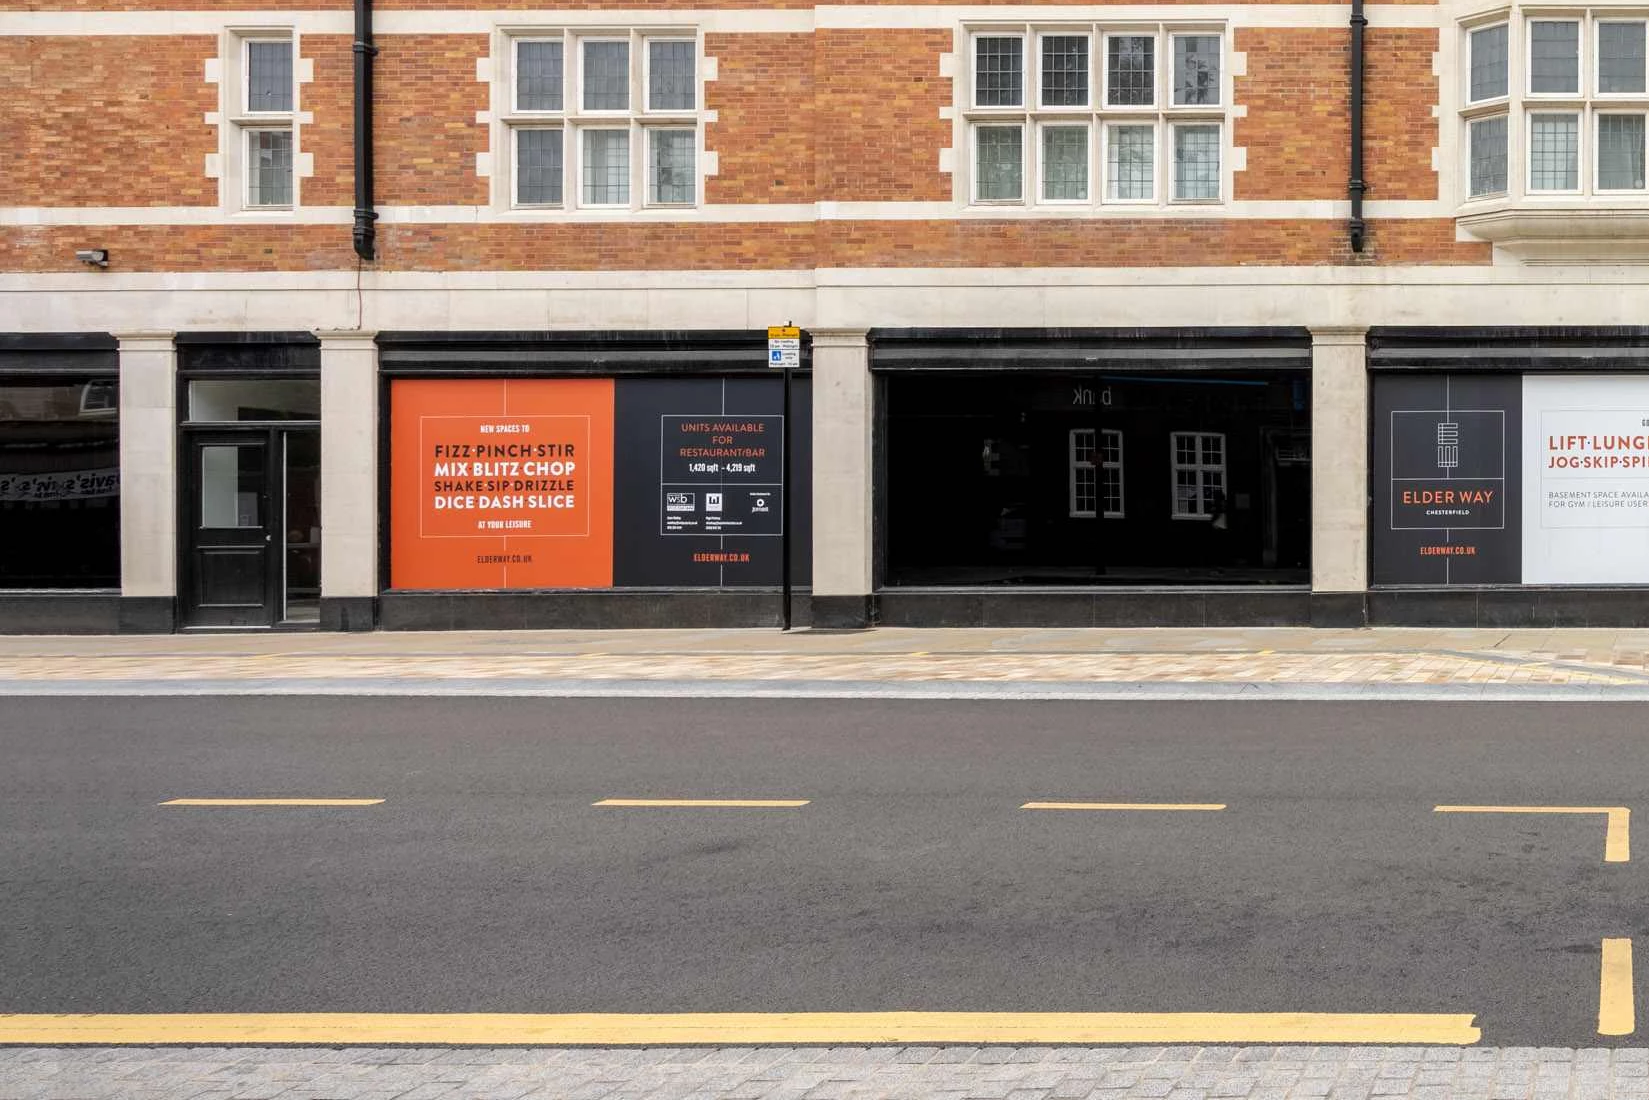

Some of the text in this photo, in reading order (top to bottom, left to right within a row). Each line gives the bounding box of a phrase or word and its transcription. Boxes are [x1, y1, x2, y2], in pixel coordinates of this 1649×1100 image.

[480, 425, 530, 433] NEW SPACES TO
[681, 423, 765, 433] UNITS AVAILABLE
[712, 435, 734, 445] FOR
[680, 448, 766, 458] RESTAURANT/BAR
[1403, 491, 1494, 504] ELDER WAY
[1548, 491, 1591, 499] BASEMENT
[1593, 491, 1619, 499] SPACE
[1548, 500, 1566, 508] FOR
[1567, 500, 1586, 508] GYM
[1592, 500, 1625, 508] LEISURE
[1627, 500, 1648, 508] USER
[478, 520, 532, 529] AT YOUR LEISURE
[1420, 547, 1476, 555] ELDERWAY.CO.UK
[477, 555, 533, 564] ELDERWAY.CO.UK
[694, 553, 750, 562] ELDERWAY.CO.UK
